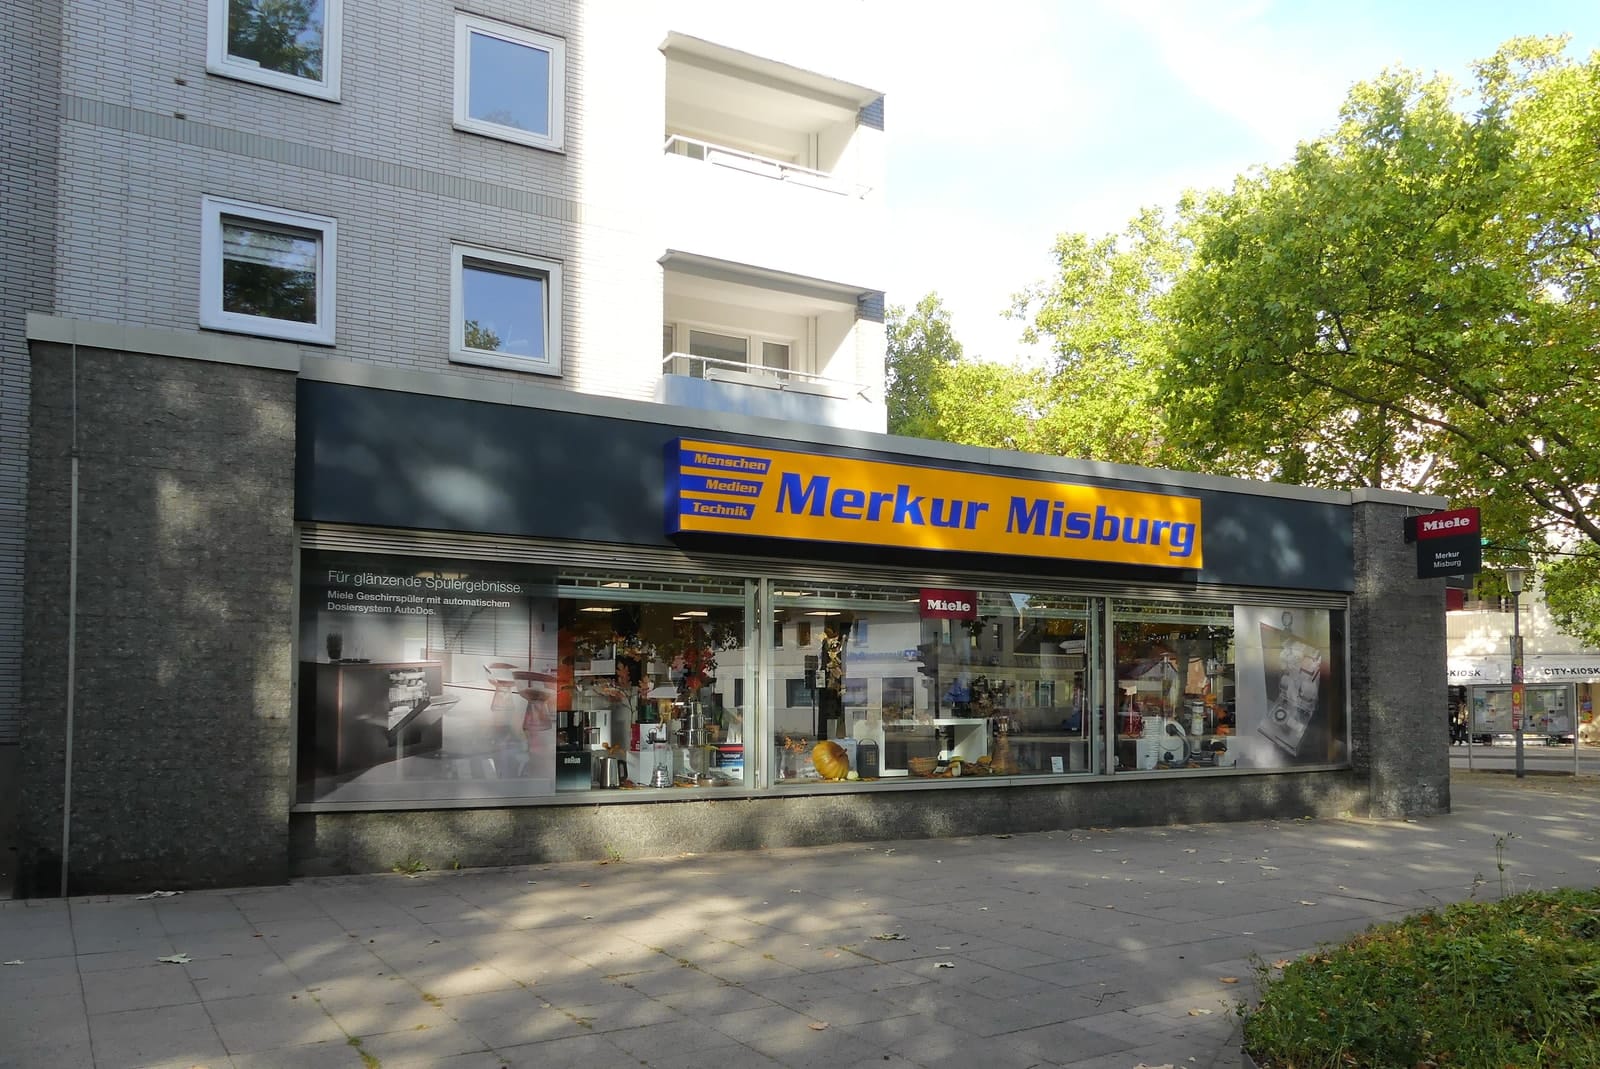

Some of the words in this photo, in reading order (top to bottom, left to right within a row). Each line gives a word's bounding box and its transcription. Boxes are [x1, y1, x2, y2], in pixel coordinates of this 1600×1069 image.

[694, 453, 766, 470] Menschen
[705, 479, 757, 493] Medien
[693, 502, 748, 516] Technik
[775, 471, 989, 530] Merkur
[1005, 495, 1196, 558] Misburg
[1423, 517, 1470, 531] Miele
[1435, 551, 1460, 559] Merkur
[1433, 560, 1462, 568] Misburg
[328, 570, 350, 583] Für
[354, 572, 422, 588] glänzende
[425, 576, 524, 593] Spülergebnisse.
[327, 590, 354, 600] Miele
[356, 591, 424, 604] Geschirrspüler
[426, 595, 441, 604] mit
[443, 596, 510, 608] automatischem
[927, 599, 971, 611] Miele
[327, 602, 392, 614] Dosiersystem
[393, 605, 437, 616] AutoDos.
[1544, 667, 1600, 675] CITY-KIOSK
